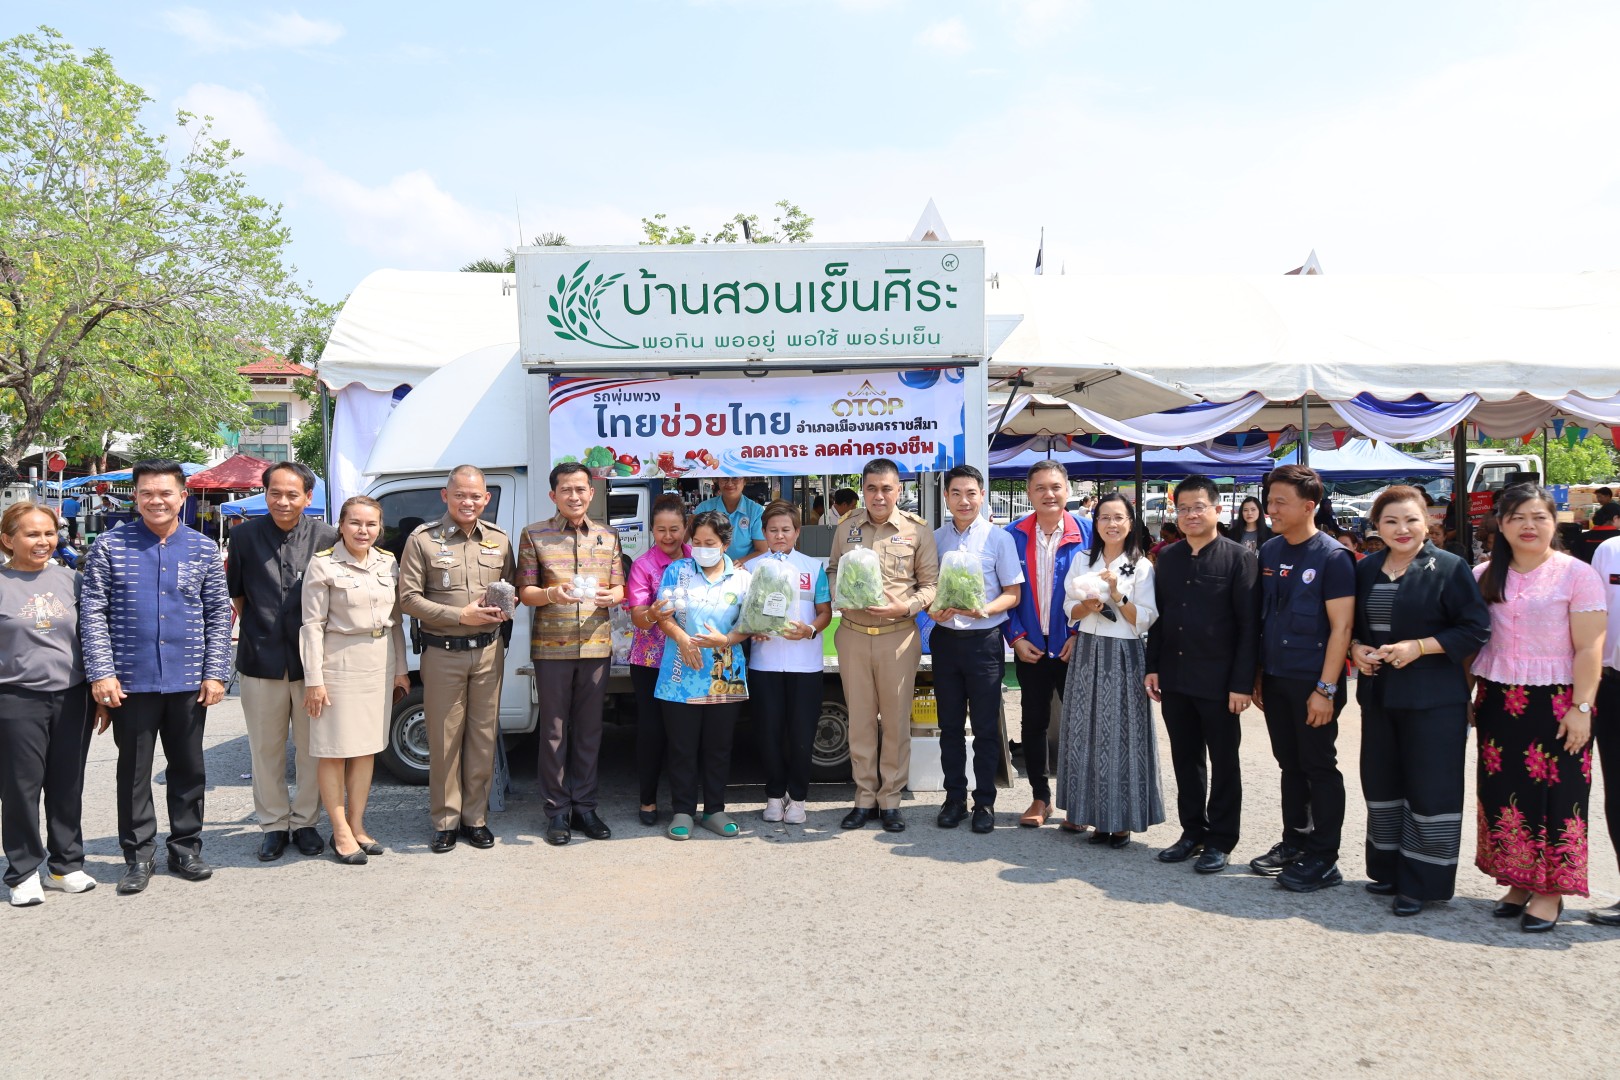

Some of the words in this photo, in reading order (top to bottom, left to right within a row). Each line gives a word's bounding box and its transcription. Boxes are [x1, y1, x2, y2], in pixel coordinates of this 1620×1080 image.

[623, 262, 957, 315] บ้านสวนเย็นศิระ
[642, 332, 704, 349] พอกิน
[715, 330, 775, 353] พออยู่
[787, 328, 839, 347] พอใช้
[847, 325, 941, 346] พอร่มเย็น
[593, 388, 661, 405] รถพุ่มพวง
[831, 397, 904, 417] OTOP
[593, 402, 792, 438] ไทยช่วยไทย
[796, 416, 938, 434] อำเภอเมืองนครราชสีมา
[740, 443, 809, 459] ลดภาระ
[814, 435, 934, 457] ลดค่าครองชีพ
